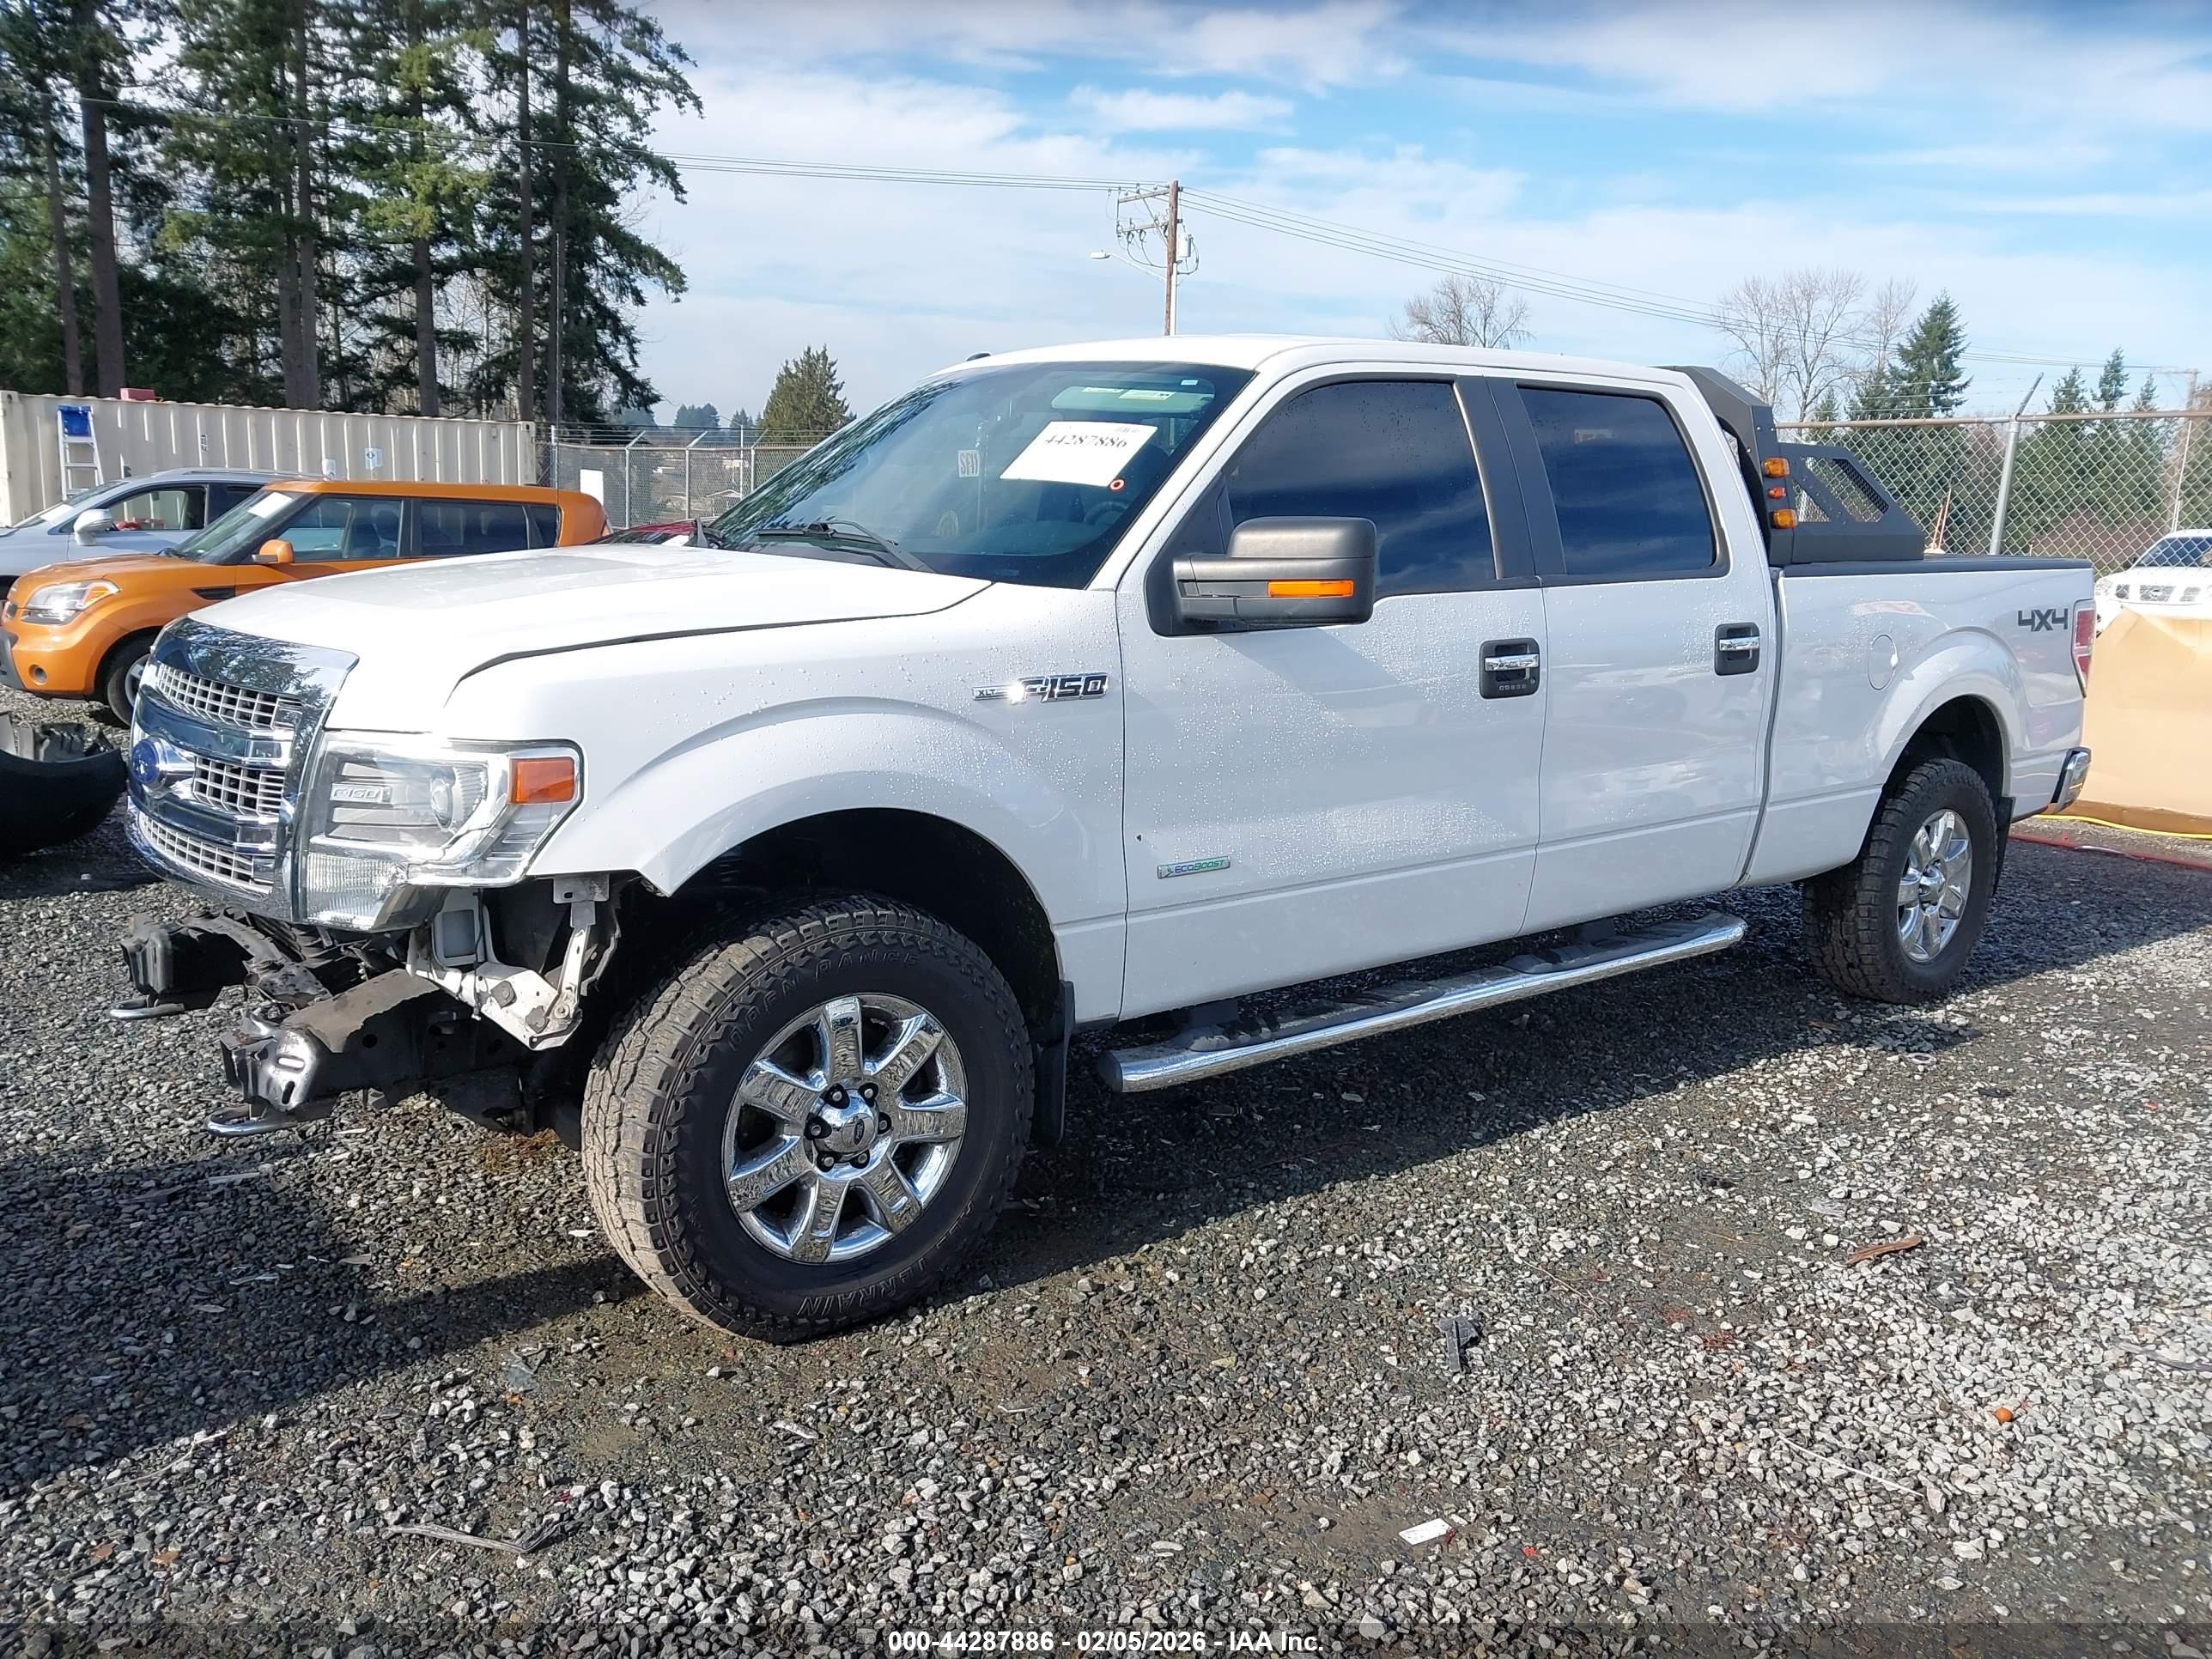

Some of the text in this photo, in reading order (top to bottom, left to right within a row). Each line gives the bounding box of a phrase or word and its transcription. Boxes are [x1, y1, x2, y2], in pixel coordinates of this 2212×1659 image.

[1044, 434, 1127, 448] 44287886
[2017, 608, 2069, 632] 4X4
[978, 689, 997, 697] XLT
